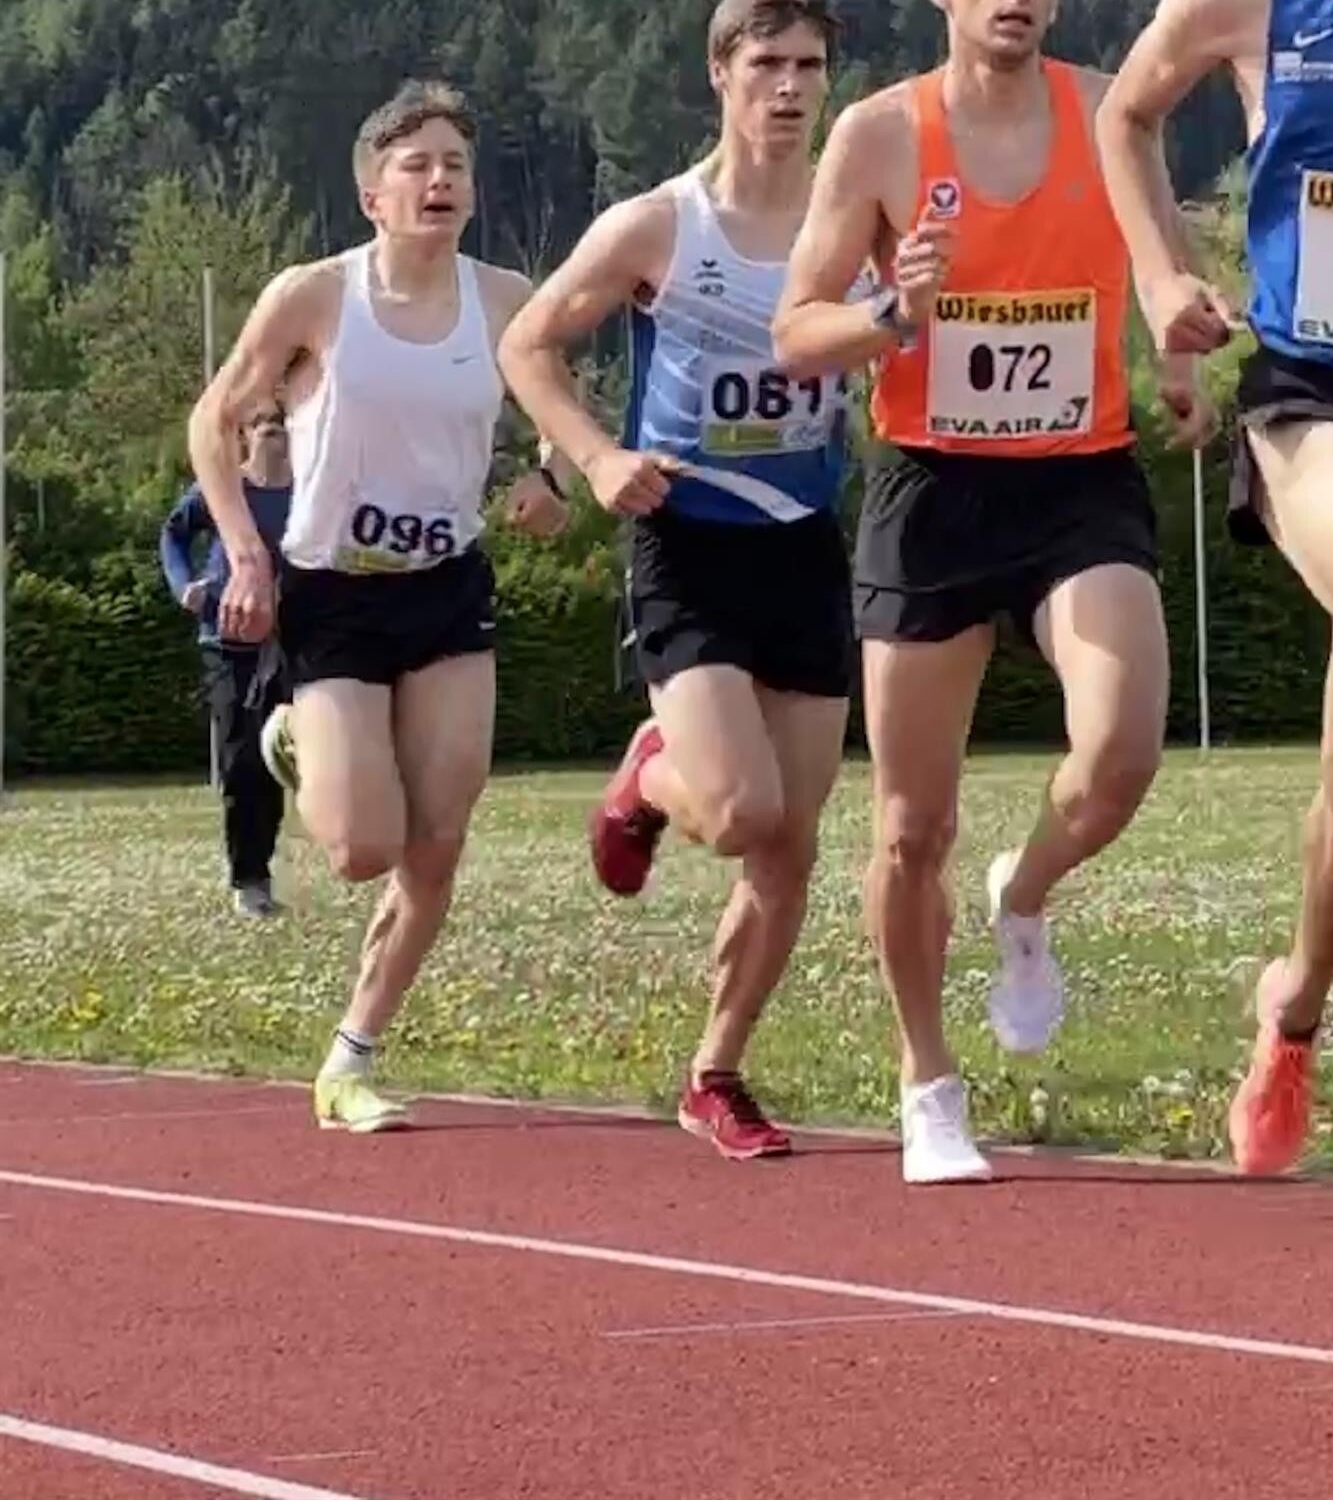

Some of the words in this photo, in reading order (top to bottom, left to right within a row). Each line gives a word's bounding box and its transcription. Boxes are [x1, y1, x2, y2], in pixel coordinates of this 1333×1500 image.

[936, 294, 1090, 324] Wiesbauer
[968, 343, 1052, 392] 072
[352, 504, 455, 556] 096
